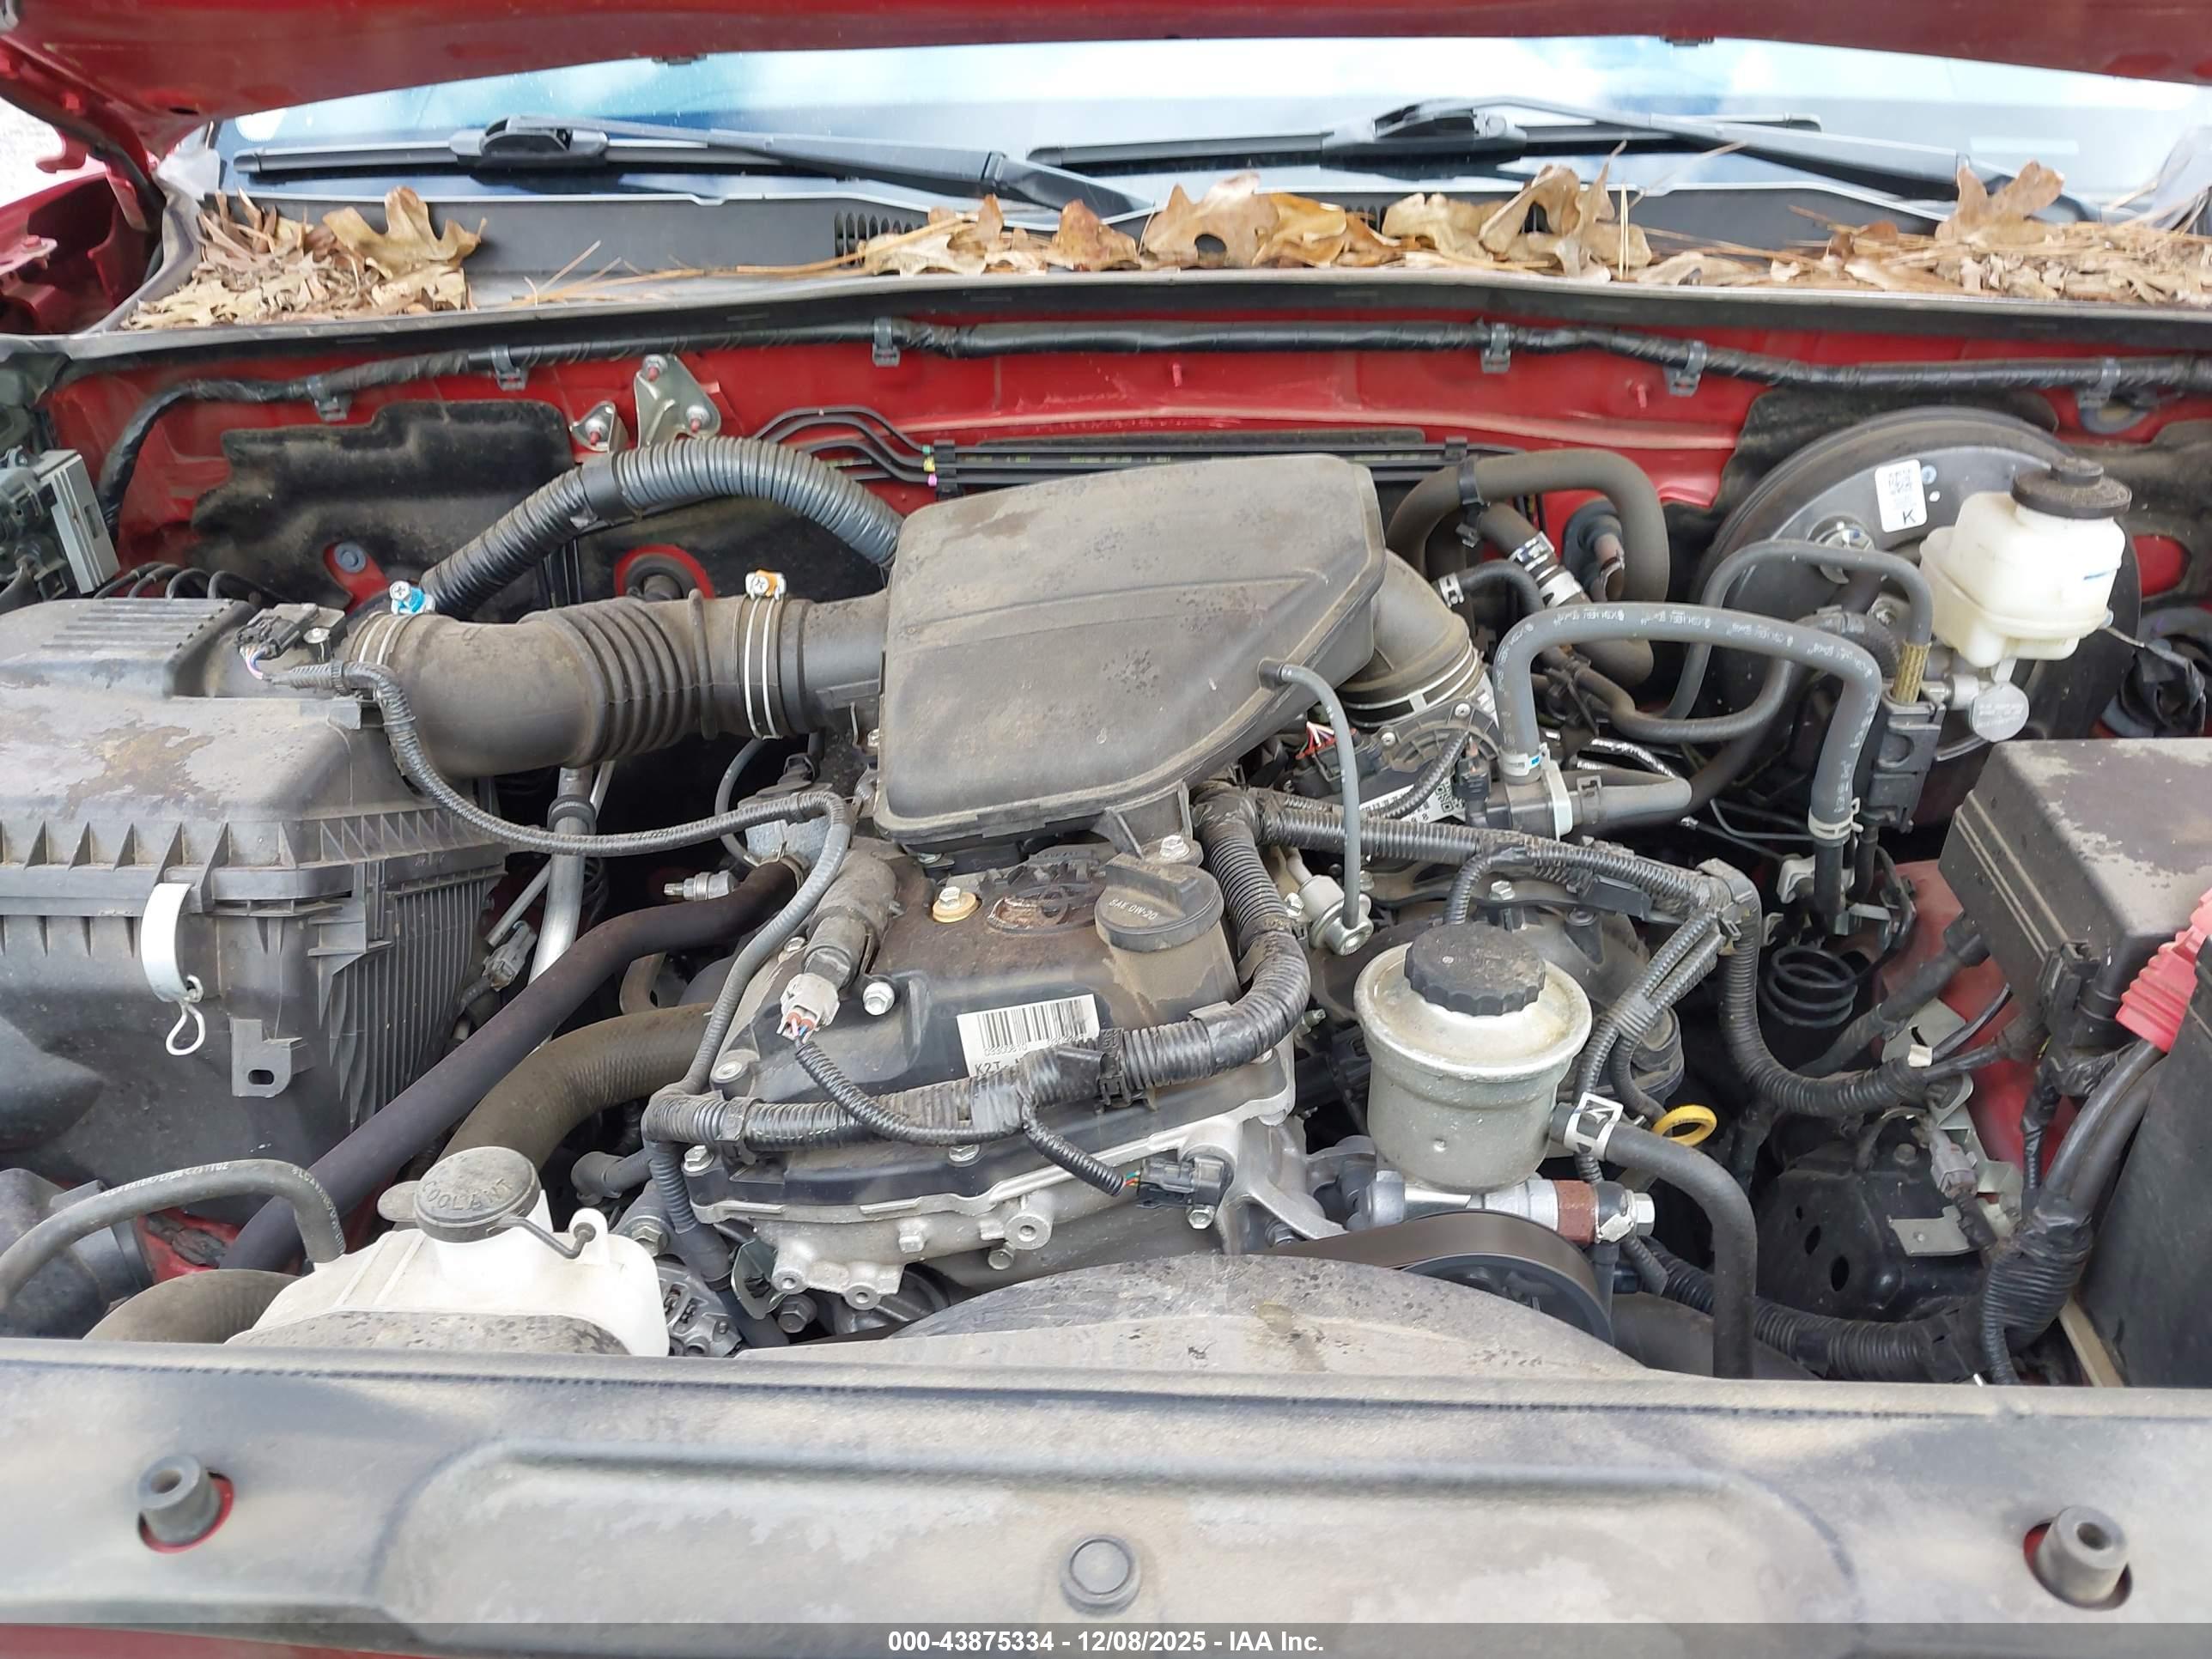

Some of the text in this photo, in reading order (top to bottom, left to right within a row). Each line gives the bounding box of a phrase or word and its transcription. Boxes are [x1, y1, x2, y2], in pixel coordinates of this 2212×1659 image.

[1902, 508, 1917, 526] K
[1108, 898, 1128, 910] SAE
[422, 1177, 513, 1211] COOLANT
